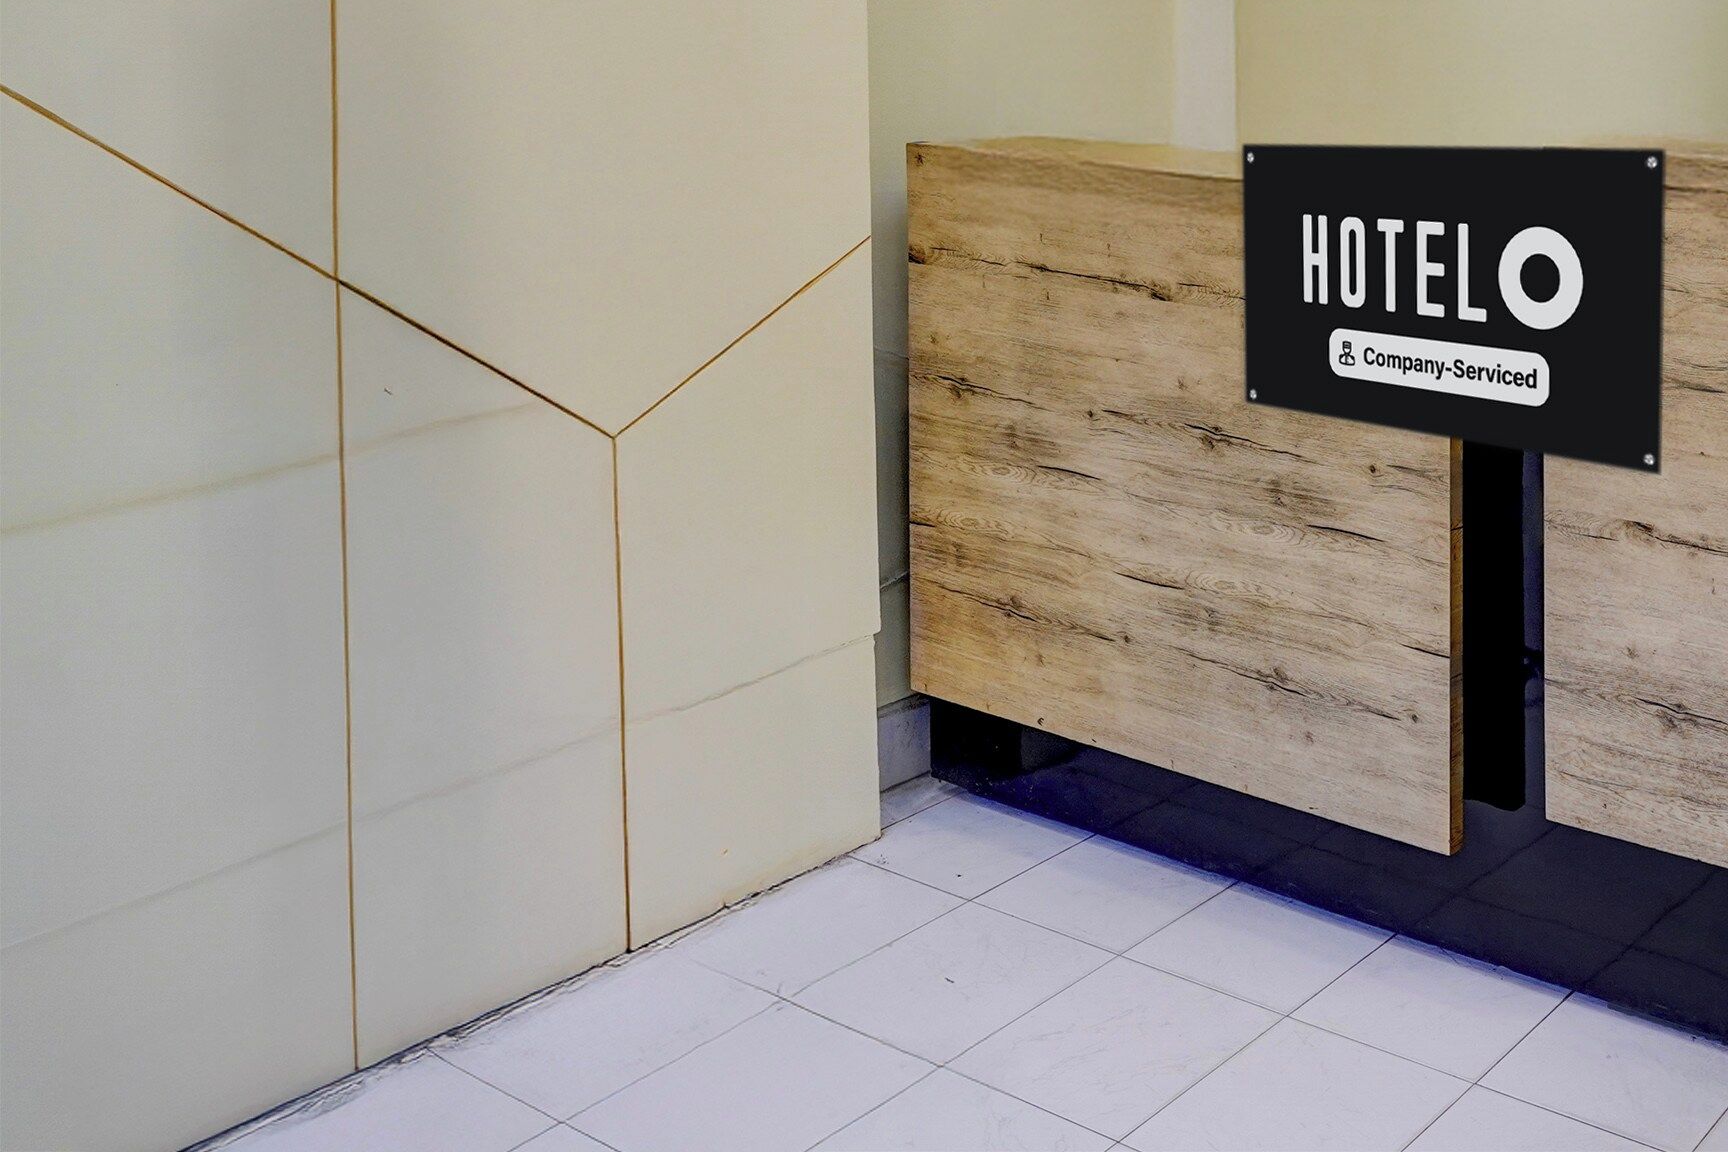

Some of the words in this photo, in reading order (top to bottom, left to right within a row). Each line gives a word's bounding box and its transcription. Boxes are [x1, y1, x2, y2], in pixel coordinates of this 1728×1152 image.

[1302, 213, 1488, 323] HOTEL
[1498, 225, 1584, 331] O
[1363, 347, 1538, 389] Company-Serviced
